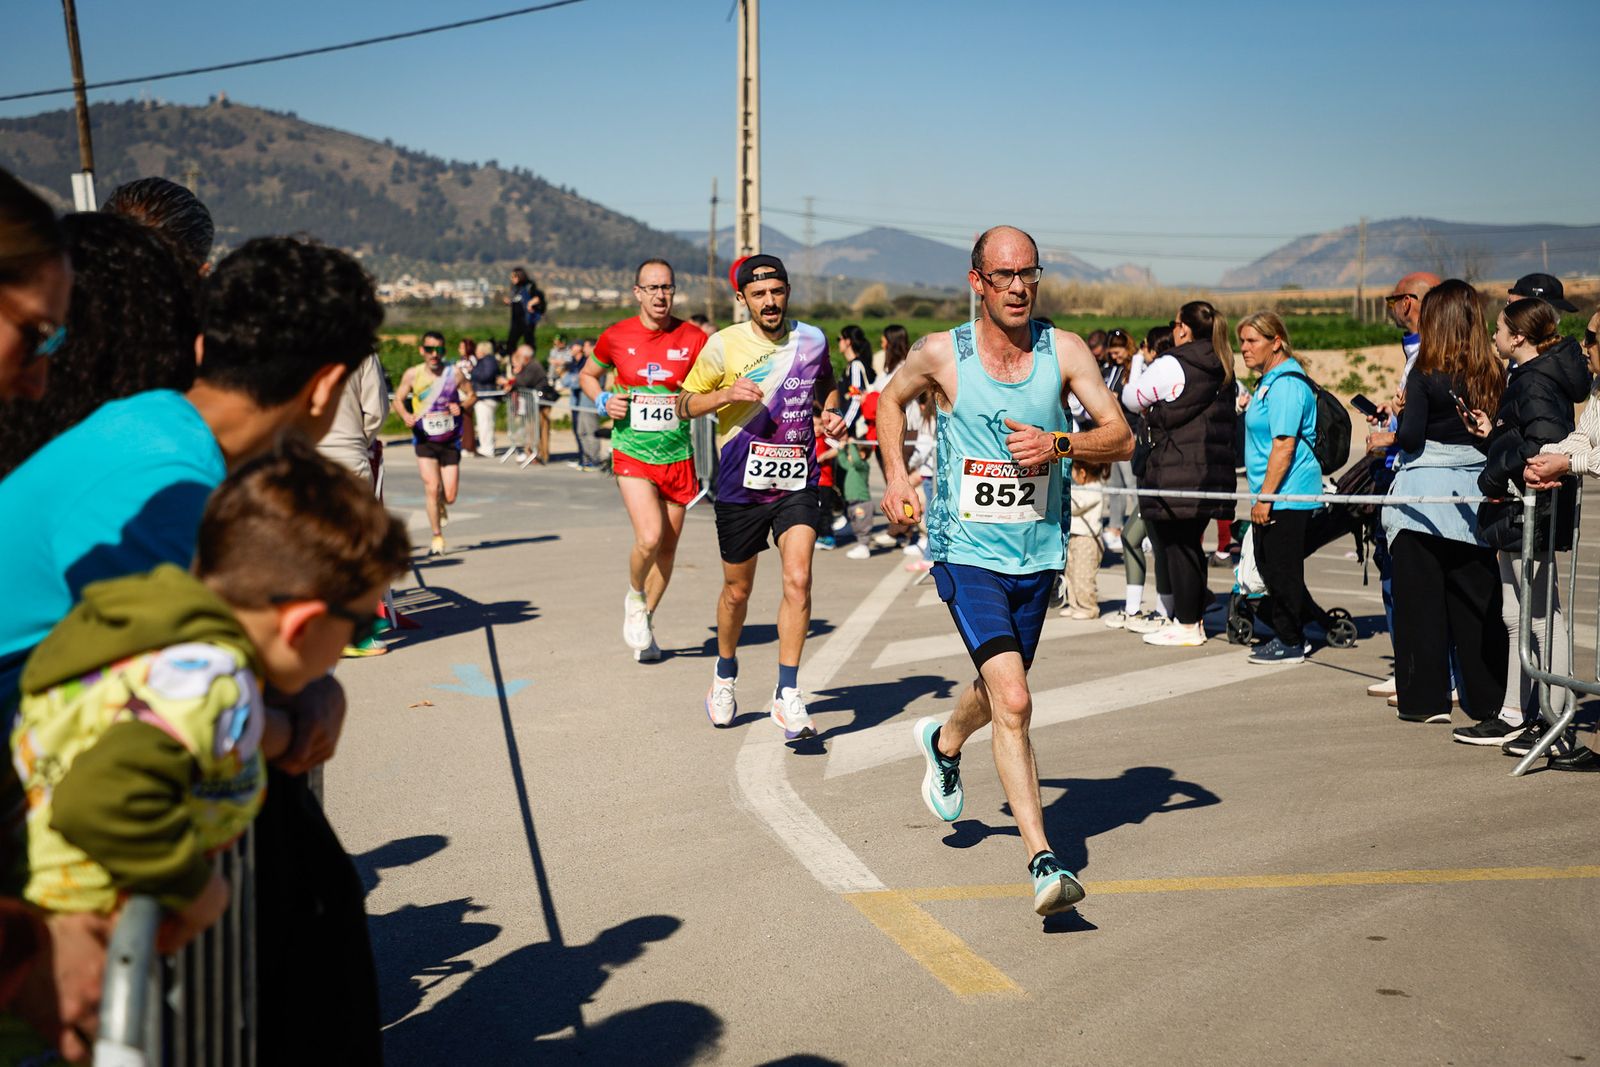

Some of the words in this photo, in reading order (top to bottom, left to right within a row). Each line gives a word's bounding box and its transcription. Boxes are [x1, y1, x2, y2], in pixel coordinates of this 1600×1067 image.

[640, 407, 673, 421] 146
[763, 447, 795, 458] FONDO
[748, 459, 805, 479] 3282
[969, 463, 984, 474] 39
[983, 467, 1030, 477] FONDO
[974, 482, 1036, 507] 852
